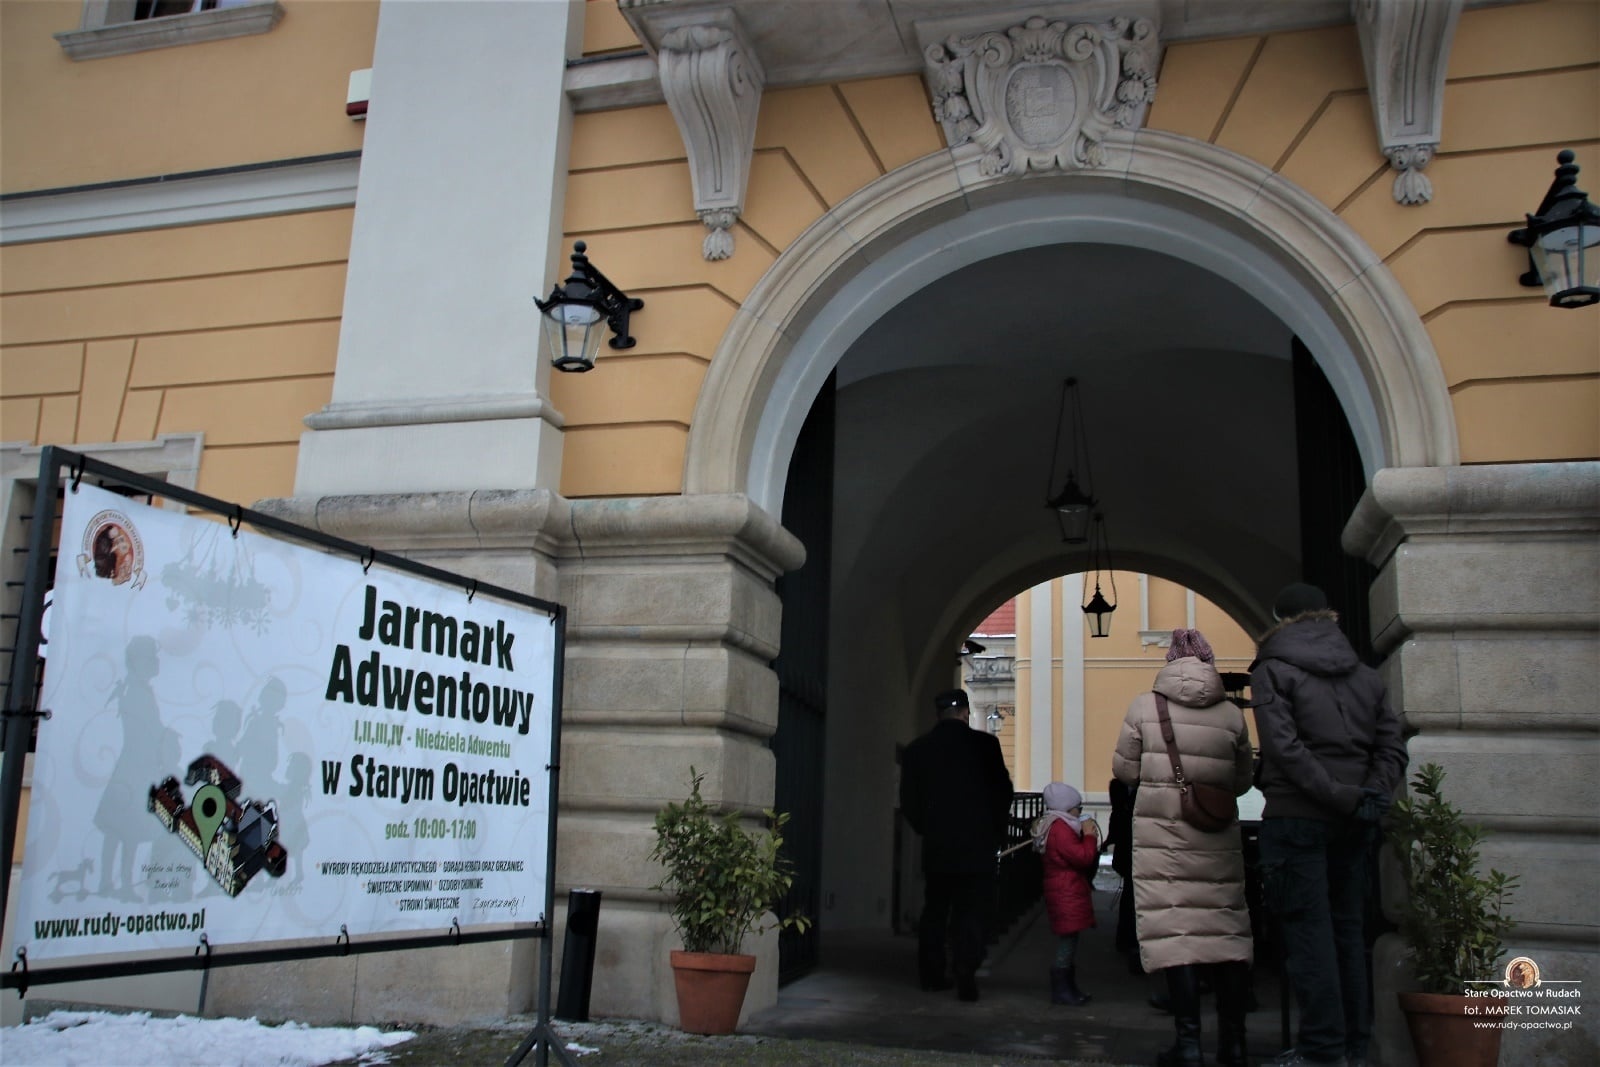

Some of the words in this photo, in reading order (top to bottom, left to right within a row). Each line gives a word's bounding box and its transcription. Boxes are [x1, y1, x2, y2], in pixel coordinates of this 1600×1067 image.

[359, 585, 515, 672] Jarmark
[325, 644, 534, 735] Adwentowy
[415, 727, 466, 753] Niedziela
[467, 735, 511, 758] Adwentu
[322, 760, 341, 795] w
[349, 754, 434, 804] Starym
[442, 762, 530, 807] Opactwie
[385, 821, 410, 840] godz.
[414, 818, 476, 840] 10:00-17:00
[322, 862, 350, 875] WYROBY
[390, 861, 437, 873] ARTYSTYCZNEGO
[496, 861, 524, 872] GRZANIEC
[403, 879, 432, 892] UPOMINKI
[34, 908, 206, 939] www.rudy-opactwo.pl
